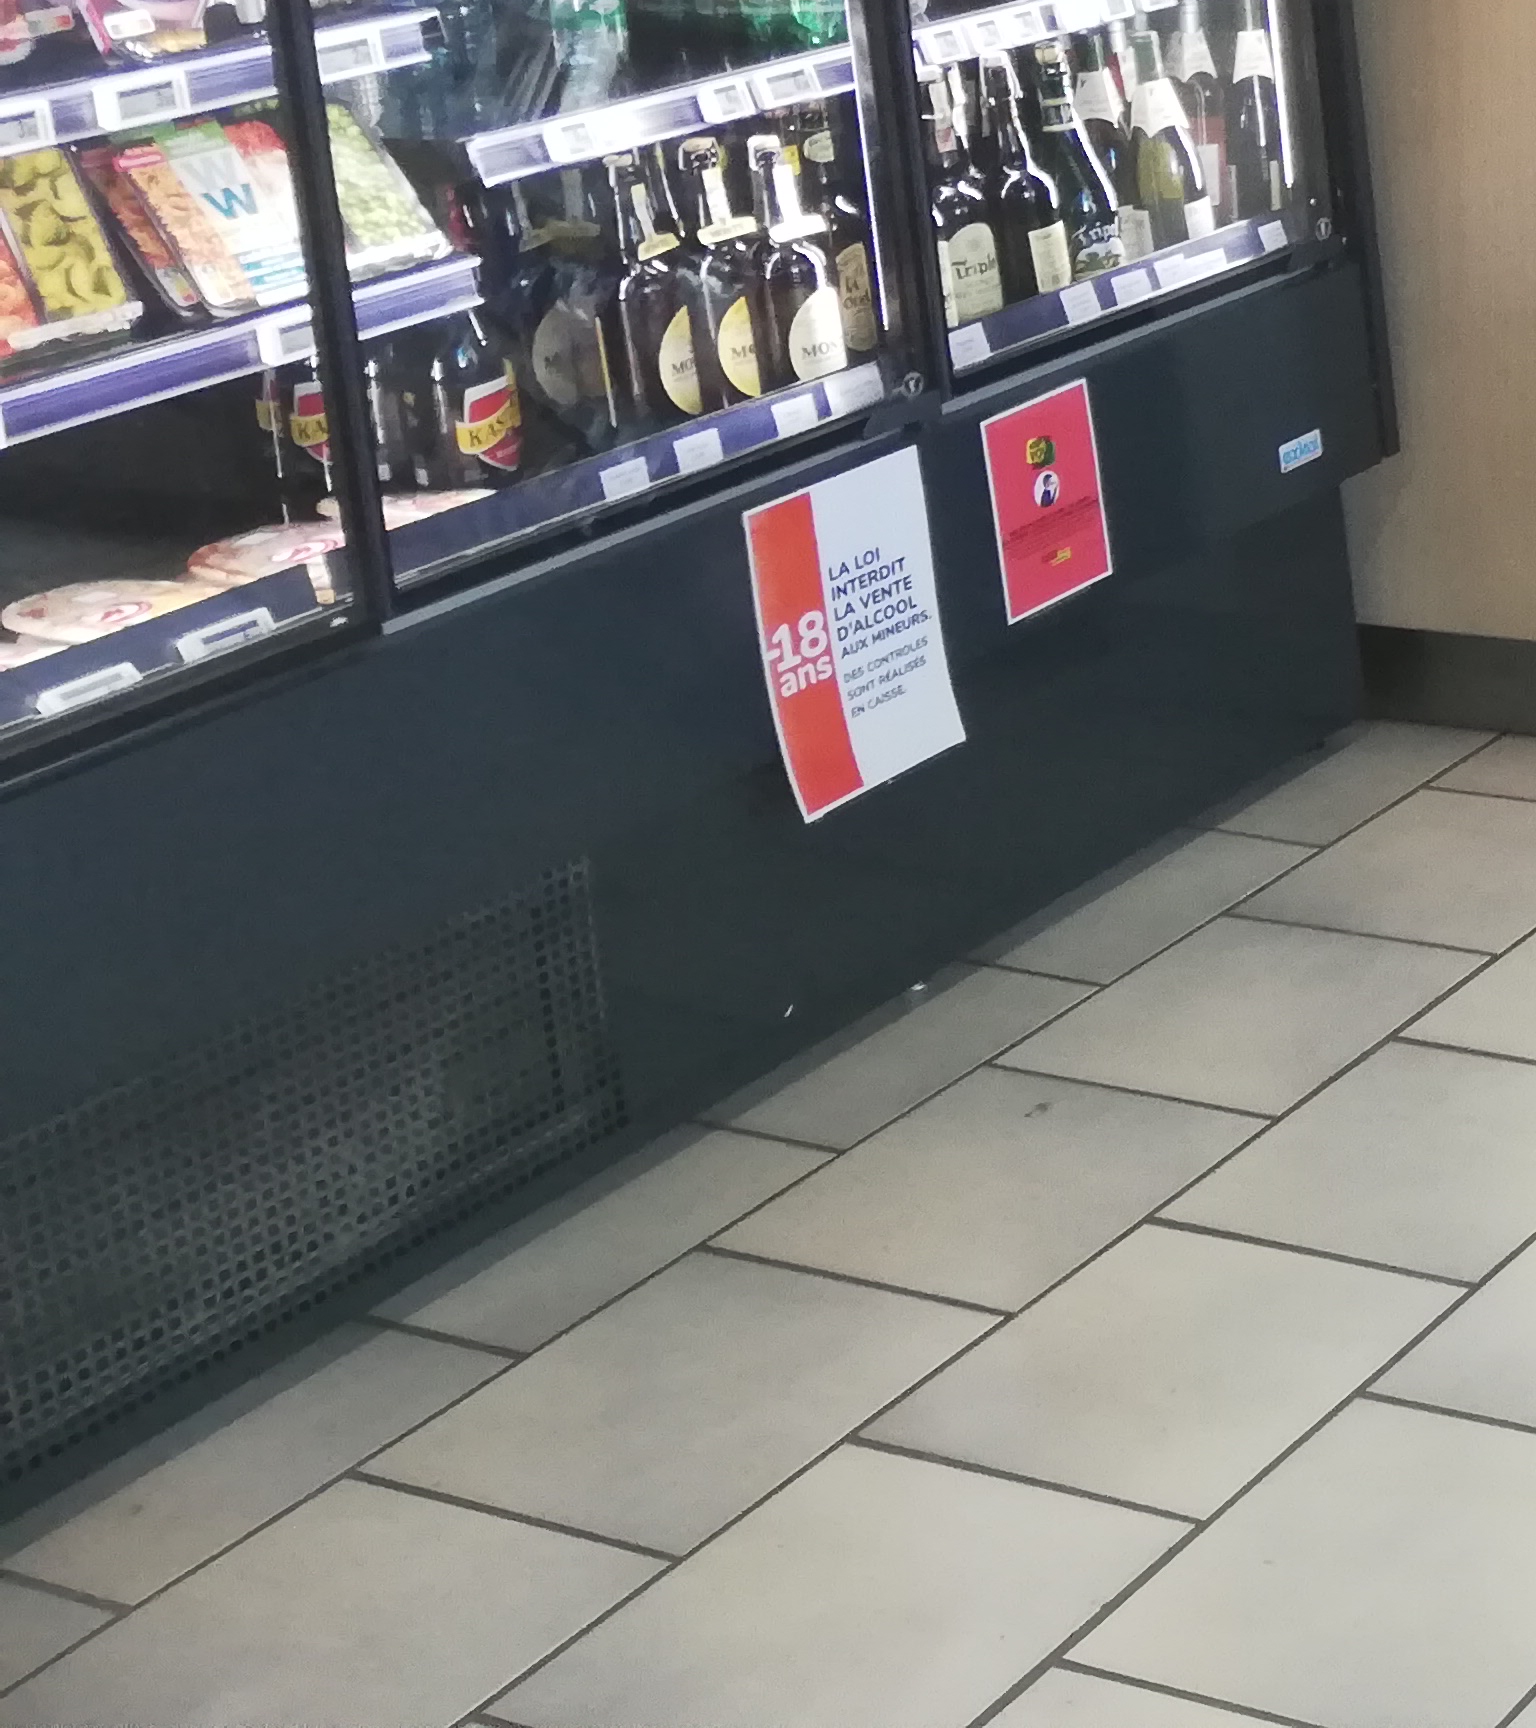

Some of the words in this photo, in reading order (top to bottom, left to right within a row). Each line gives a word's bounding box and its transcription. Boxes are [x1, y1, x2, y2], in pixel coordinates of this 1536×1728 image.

[828, 563, 849, 581] LA
[854, 546, 881, 572] LOI
[831, 557, 906, 601] INTERDIT
[833, 601, 855, 622] LA
[859, 575, 913, 610] VENTE
[837, 599, 917, 642] D'ALCOOL
[841, 638, 868, 659] AUX
[872, 612, 933, 647] MINEURS.
[780, 656, 833, 698] ans
[847, 680, 876, 701] SONT
[850, 704, 866, 718] EN
